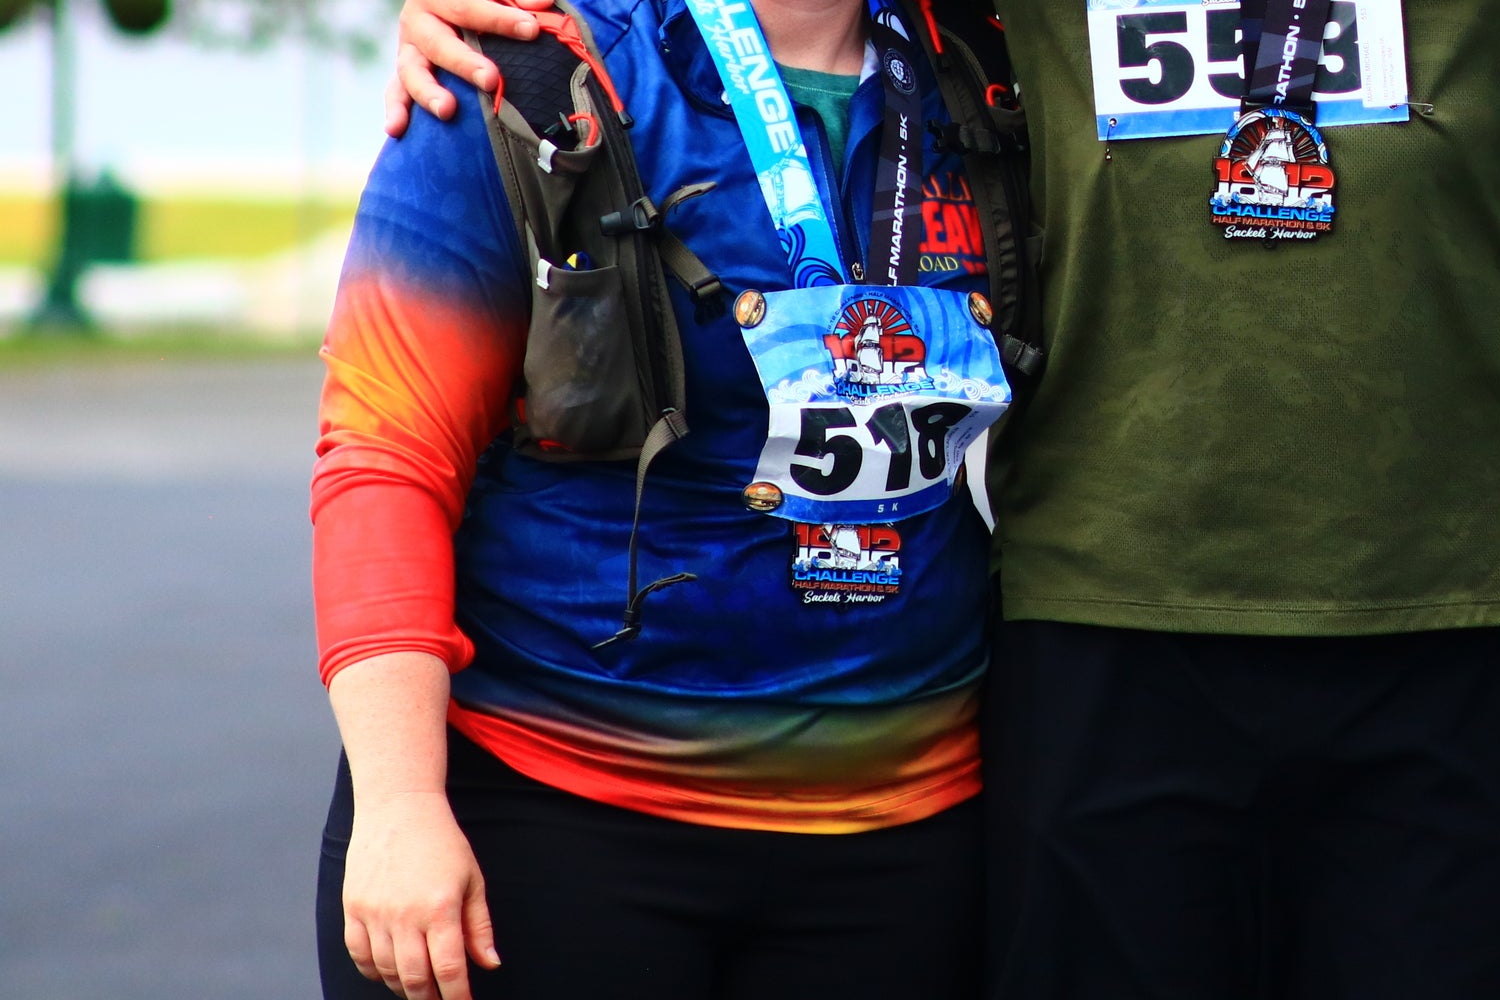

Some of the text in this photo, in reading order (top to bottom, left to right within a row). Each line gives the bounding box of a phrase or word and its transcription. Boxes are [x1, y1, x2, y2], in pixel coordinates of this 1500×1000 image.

[889, 154, 907, 266] MARATHON
[900, 113, 908, 140] 5K
[1212, 205, 1332, 222] CHALLENGE
[1213, 216, 1242, 225] HALF
[1242, 218, 1305, 229] MARATHON
[1315, 222, 1331, 231] 5K
[1269, 226, 1316, 239] Harbor
[918, 255, 959, 272] OAD
[837, 380, 934, 397] CHALLENGE
[790, 402, 973, 495] 518
[794, 570, 900, 585] CHALLENGE
[794, 581, 820, 589] HALF
[820, 582, 876, 593] MARATHON
[843, 591, 885, 603] Harbor
